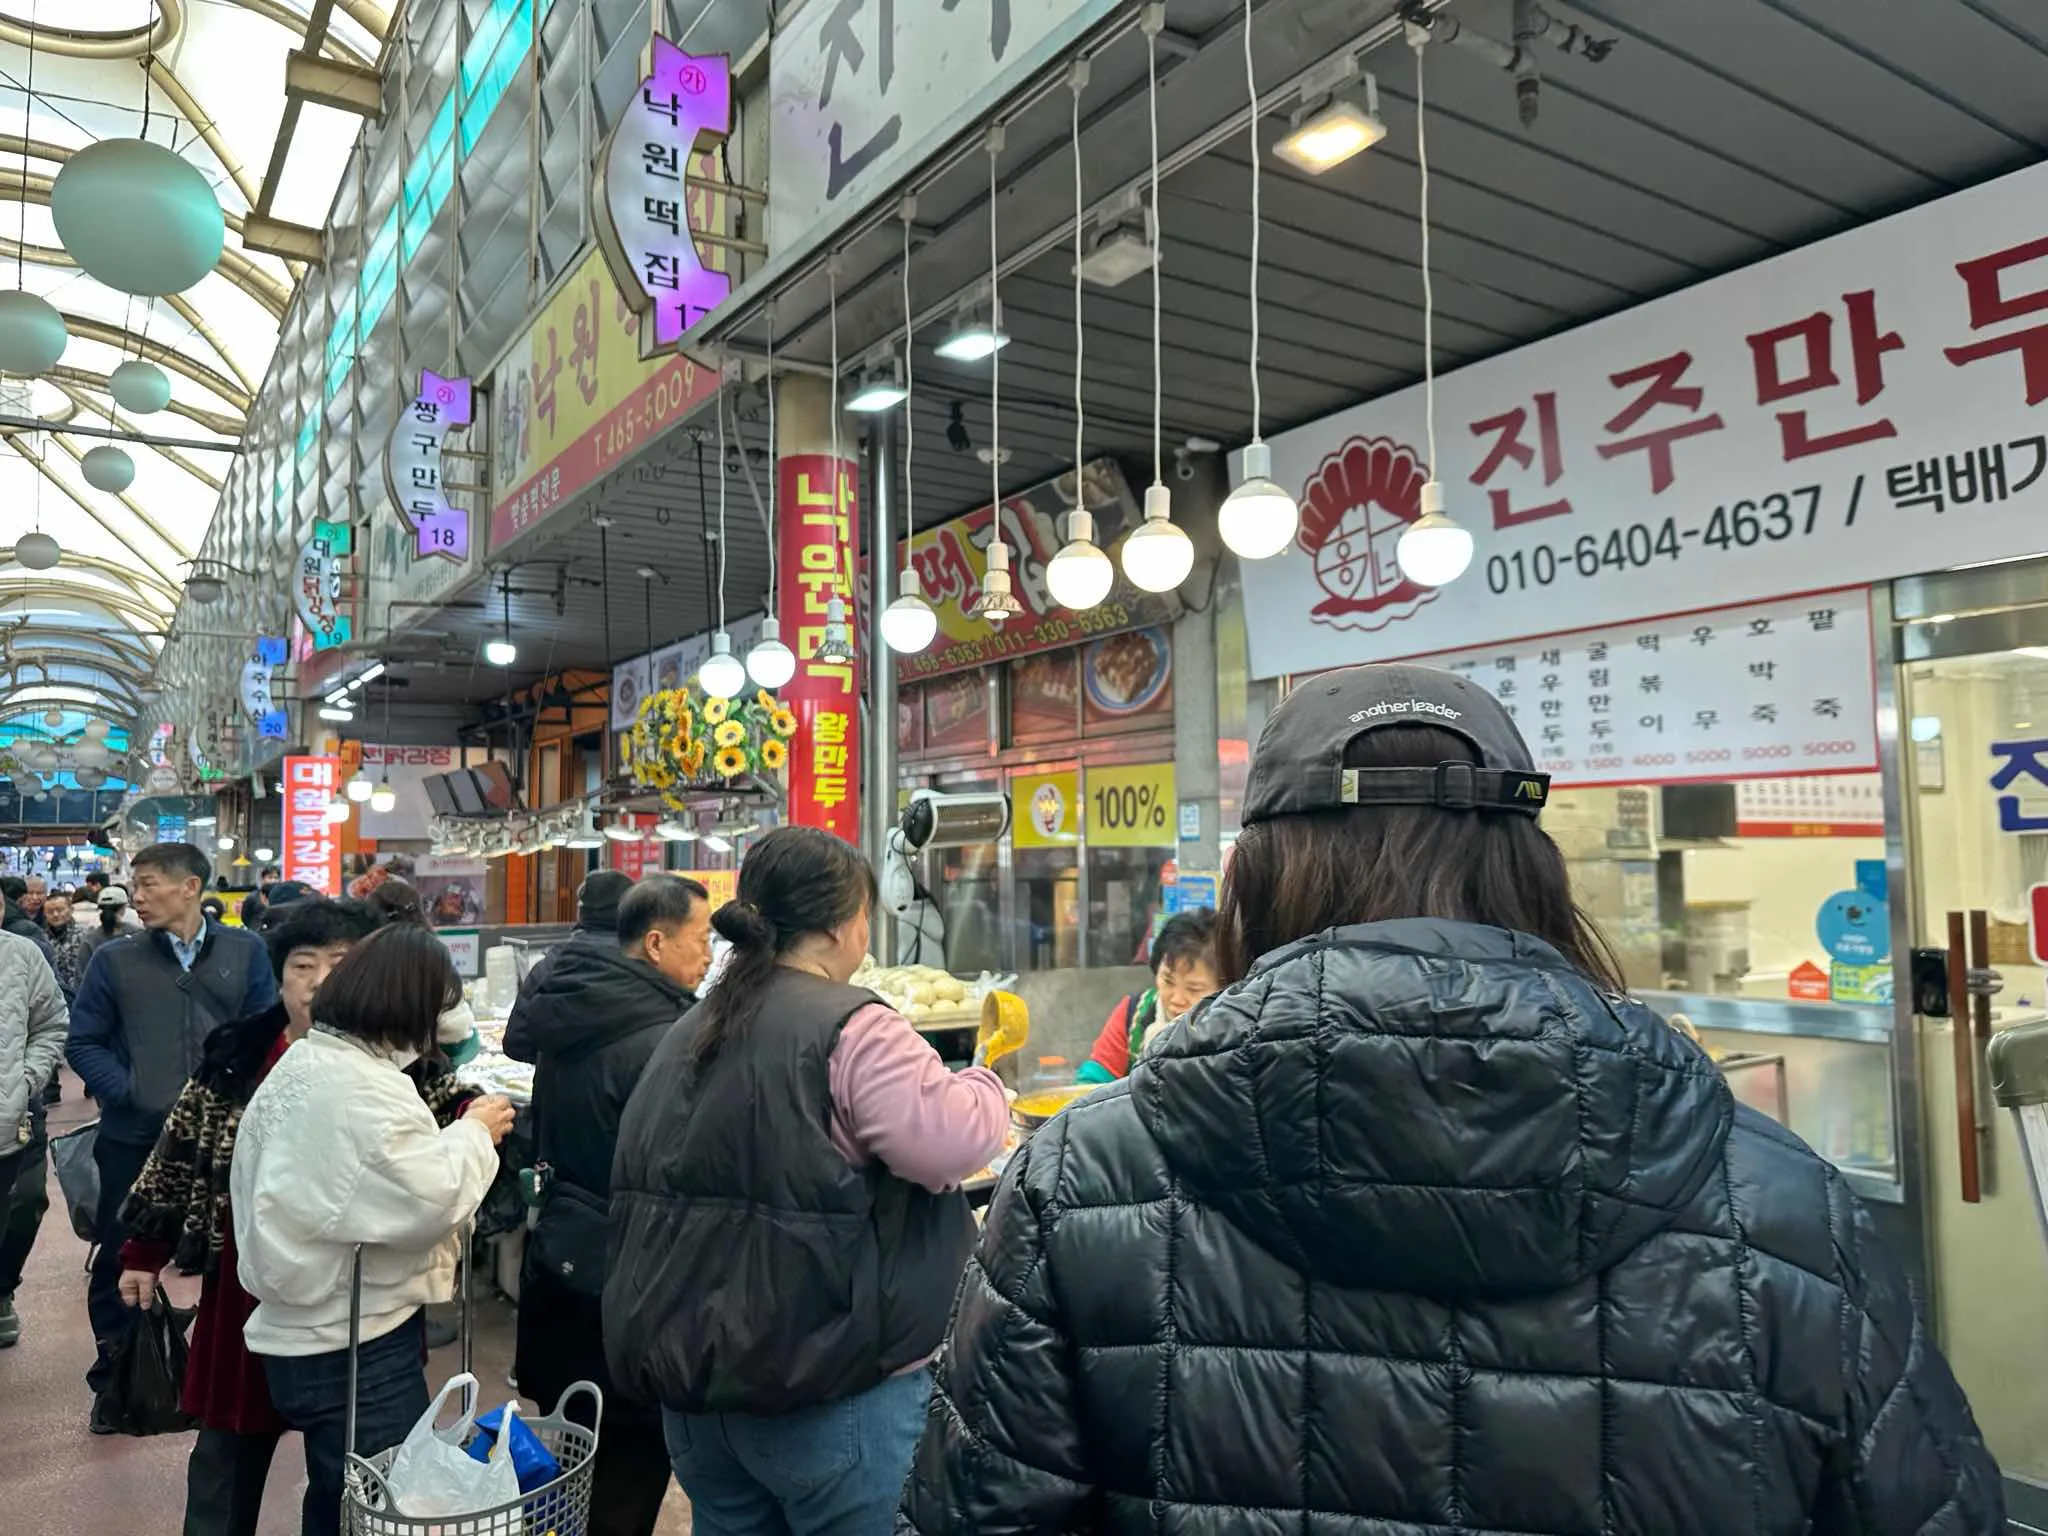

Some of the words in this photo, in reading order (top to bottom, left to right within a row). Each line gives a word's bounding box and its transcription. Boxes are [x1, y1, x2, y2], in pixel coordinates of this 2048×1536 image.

[643, 87, 682, 291] 낙원떡집
[410, 401, 440, 521] 짱구만두
[431, 527, 455, 547] 18
[1487, 486, 1823, 594] 010-6404-4637
[994, 604, 1128, 653] 011-330-6363
[1747, 618, 1778, 724] 호박죽
[1540, 649, 1563, 742] 새우만두
[1637, 634, 1663, 733] 떡볶이
[1690, 626, 1720, 730] 우무
[265, 723, 282, 734] 20
[813, 711, 848, 807] 왕만두
[1632, 752, 1676, 766] 4000
[1686, 749, 1732, 764] 5000
[1743, 745, 1792, 759] 5000
[1804, 741, 1856, 756] 5000
[1095, 783, 1166, 829] 100%
